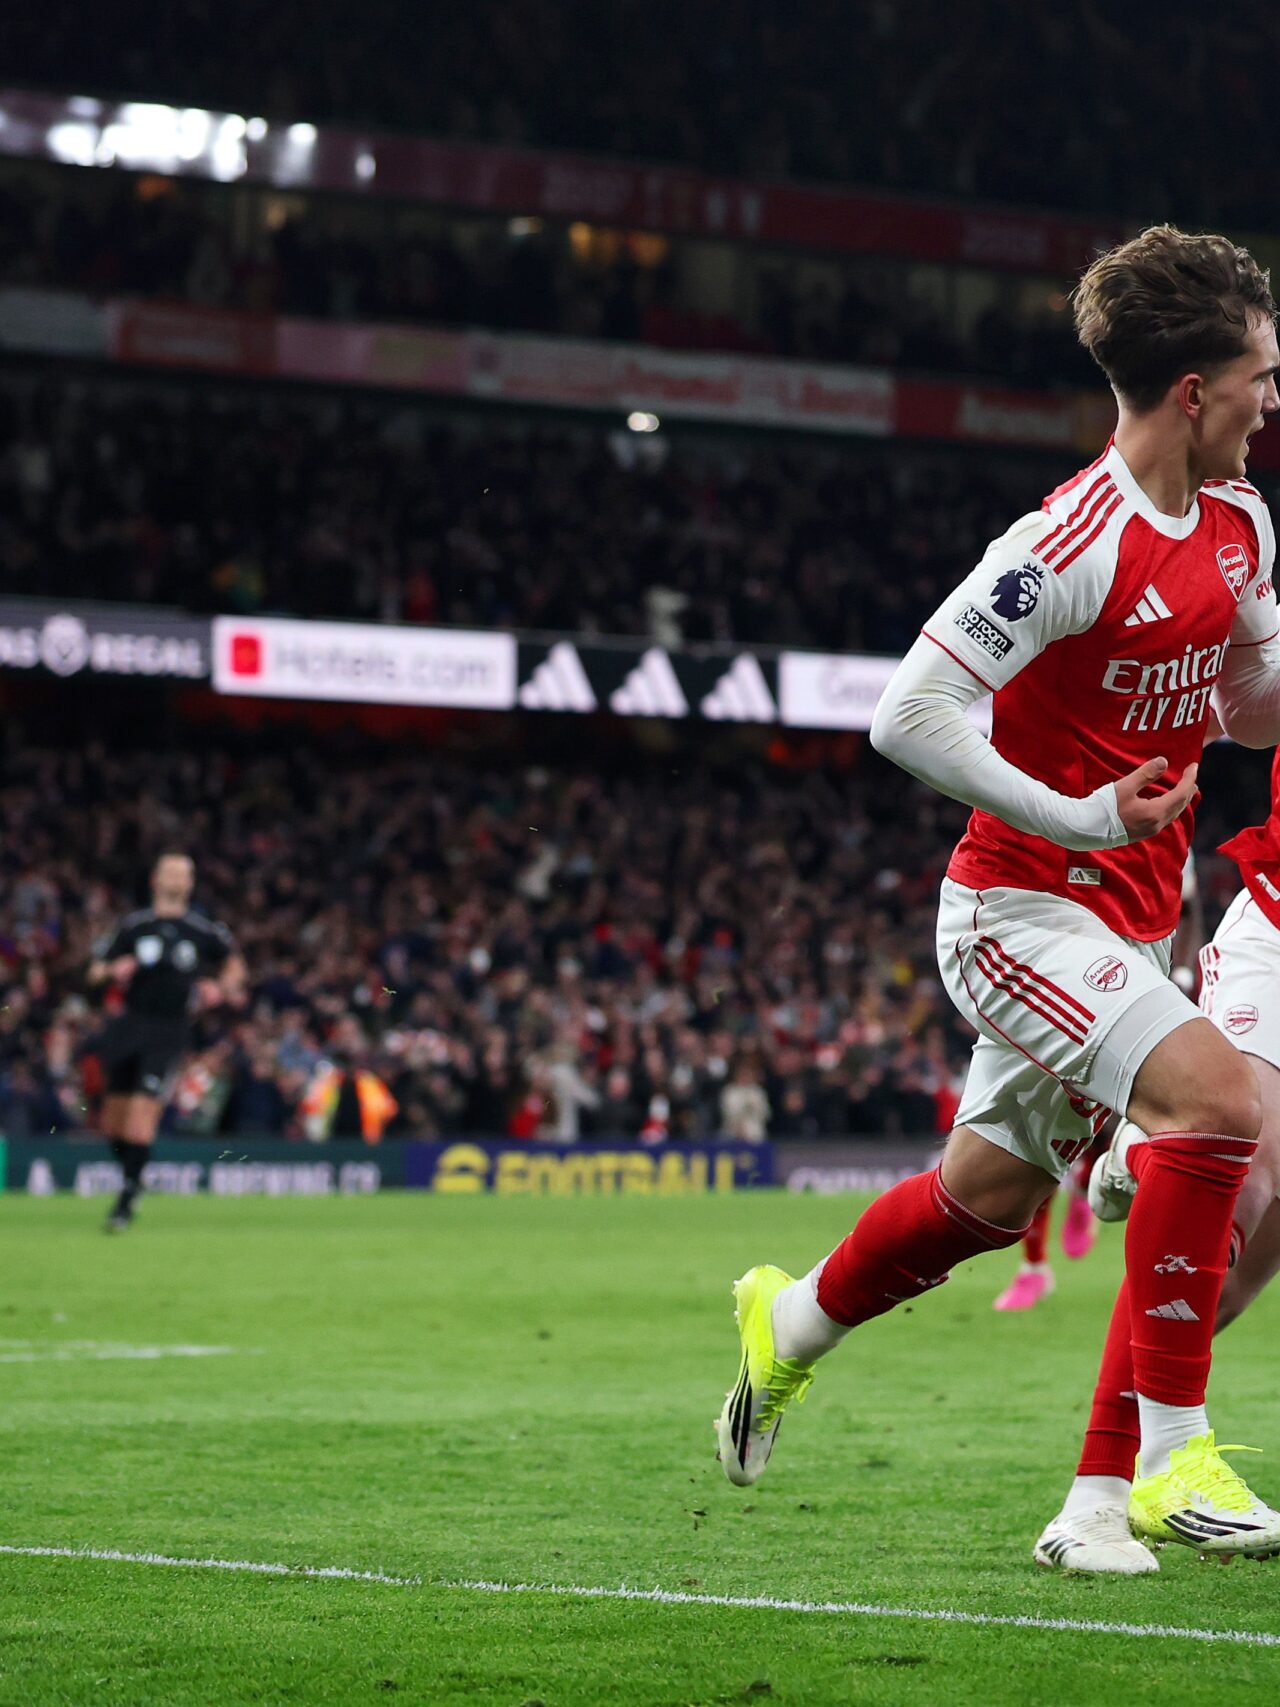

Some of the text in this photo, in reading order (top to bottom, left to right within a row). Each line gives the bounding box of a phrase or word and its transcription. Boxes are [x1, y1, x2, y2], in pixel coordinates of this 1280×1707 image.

[955, 614, 1005, 661] for racism
[962, 606, 1008, 649] No room
[1122, 686, 1210, 731] FLY BET
[1089, 959, 1115, 981] Arsenal
